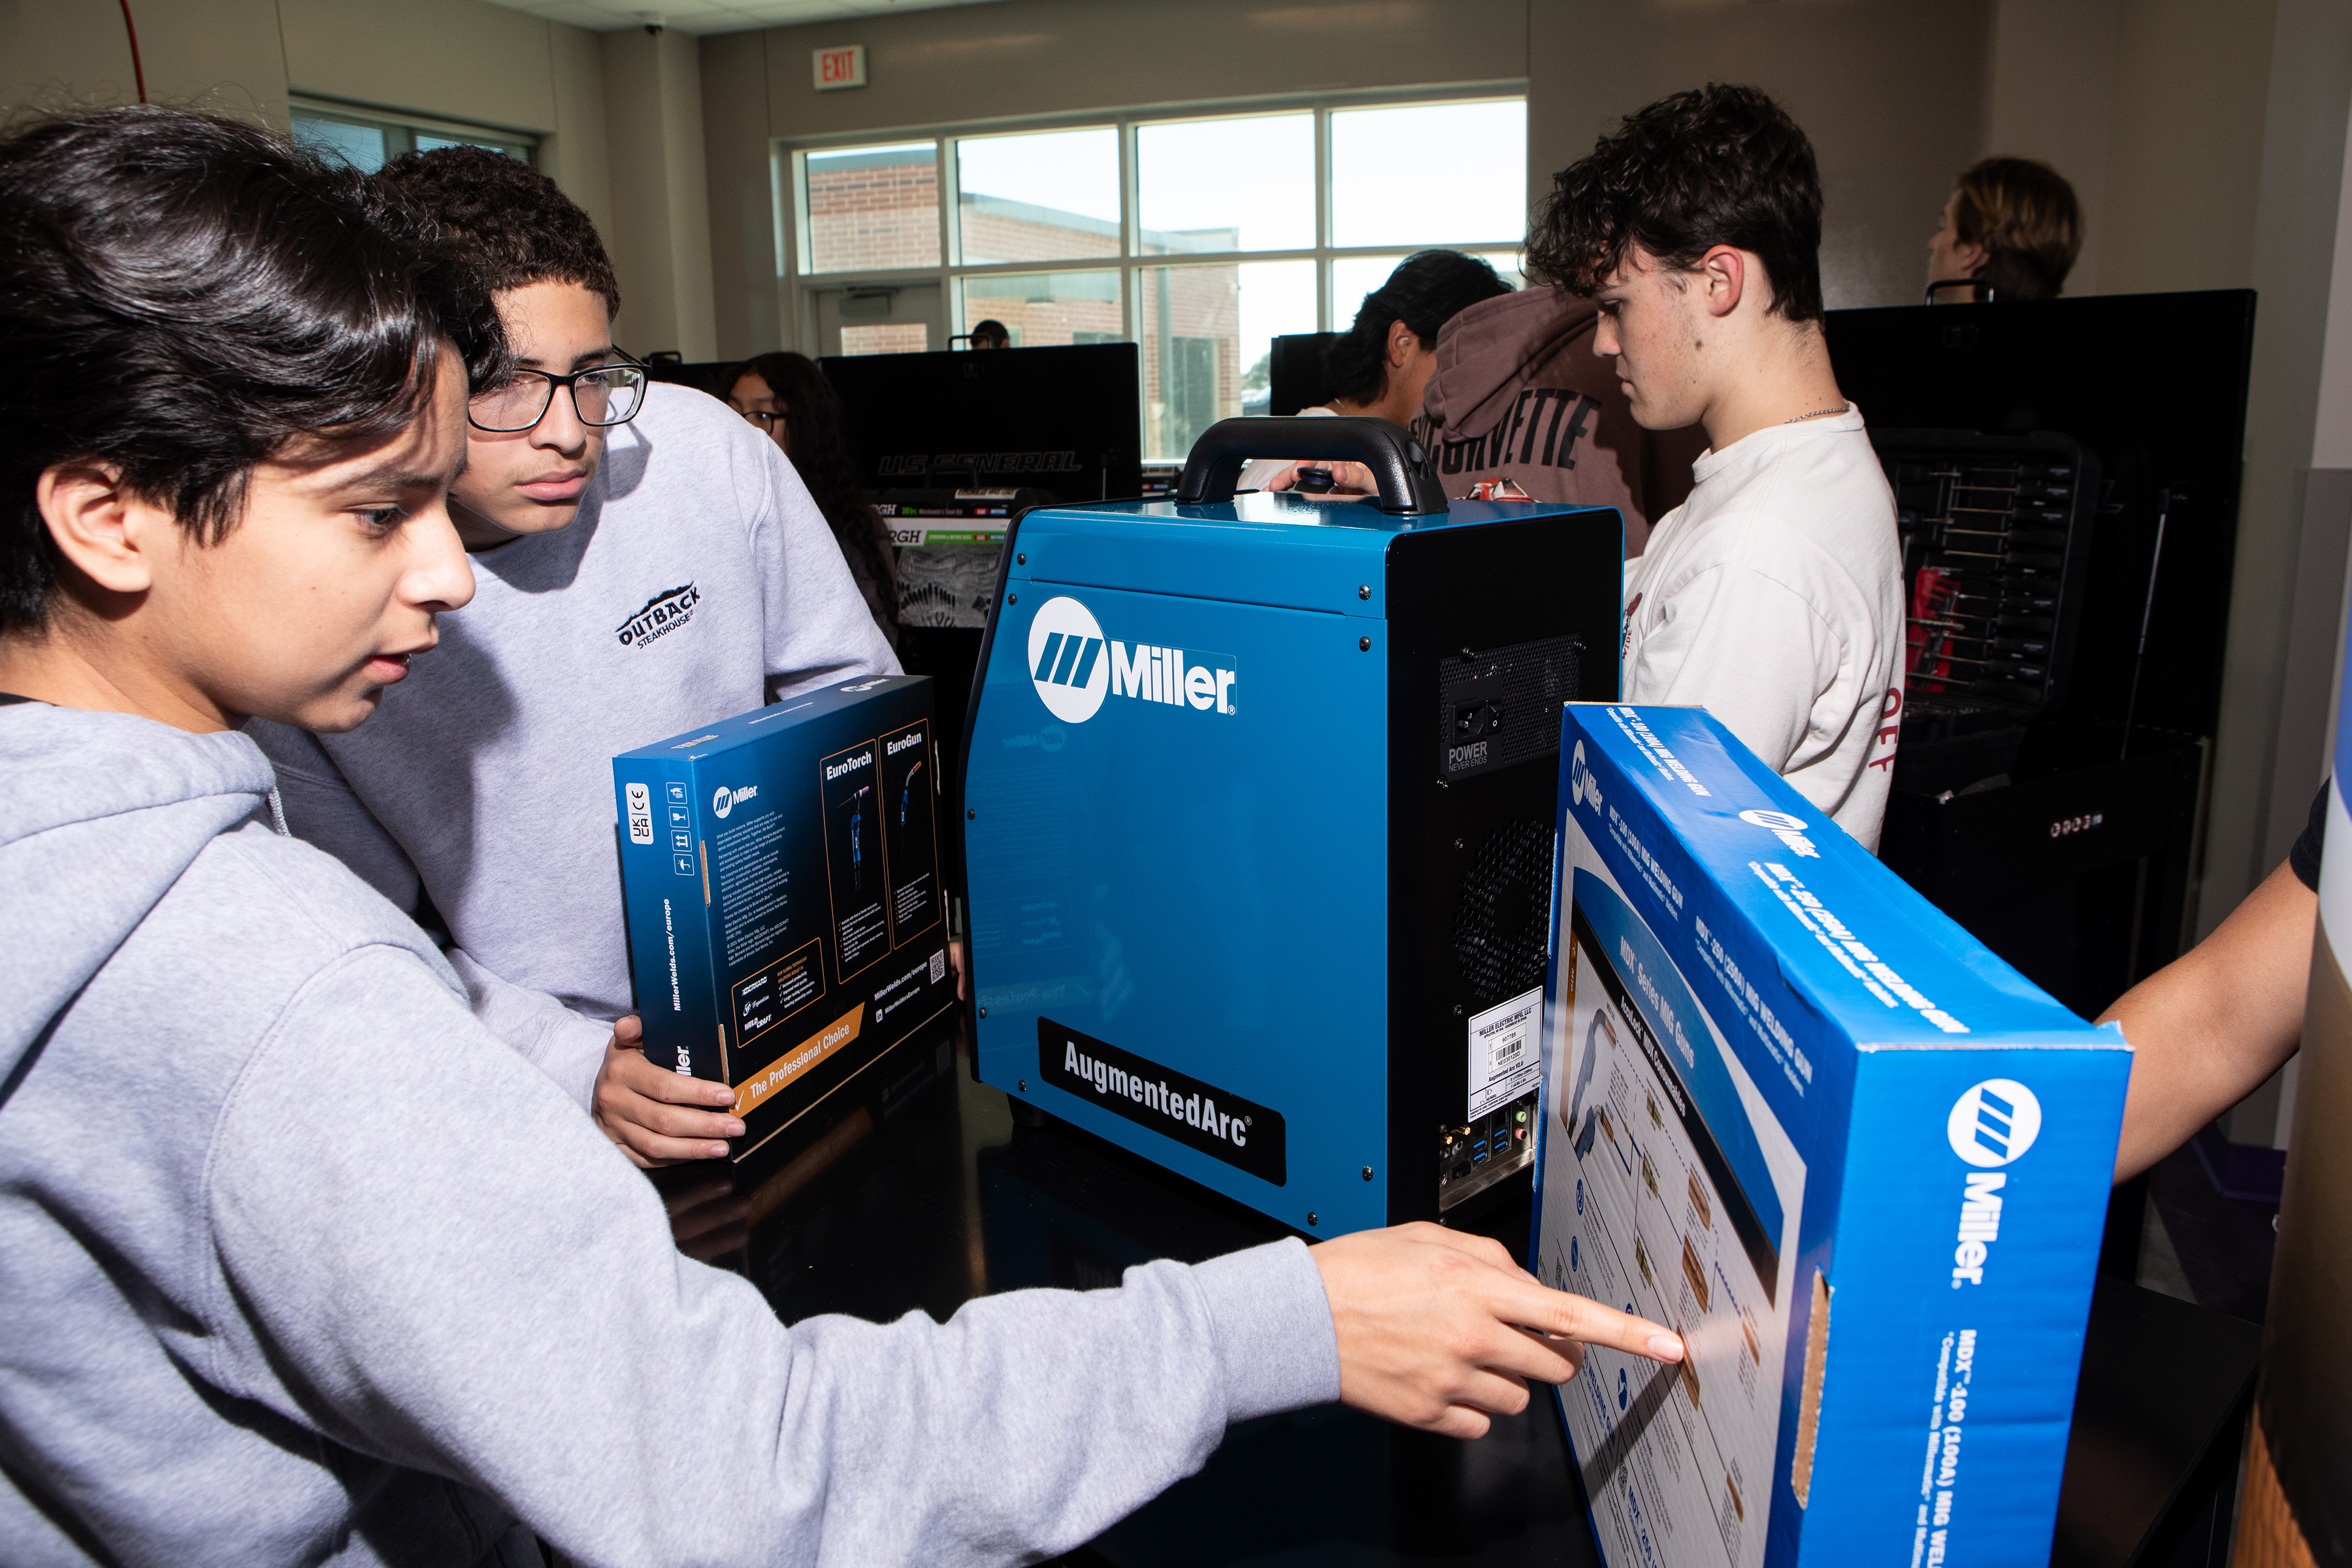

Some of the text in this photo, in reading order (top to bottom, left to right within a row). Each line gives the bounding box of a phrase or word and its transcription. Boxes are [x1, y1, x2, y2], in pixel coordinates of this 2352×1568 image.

[823, 50, 855, 83] EXIT
[619, 587, 701, 646] OUTBACK
[887, 731, 923, 757] EuroGun
[1448, 741, 1488, 765] POWER
[1653, 748, 1674, 759] MIG
[826, 751, 873, 781] EuroTorch
[1448, 755, 1488, 773] NEVER ENDS
[1663, 759, 1698, 783] WELDING
[1687, 783, 1712, 796] GUN
[717, 836, 732, 845] dependable
[1627, 829, 1641, 857] (100A)
[1641, 846, 1650, 868] MIG
[1650, 857, 1671, 894] WELDING
[1672, 885, 1683, 909] GUN
[664, 898, 682, 1012] MillerWelds.com/europe
[874, 962, 927, 1001] MillerWelds.com/europe
[1840, 940, 1878, 962] MIG
[1864, 962, 1935, 1009] WELDING
[1920, 1009, 1970, 1033] GUN
[885, 987, 920, 1014] MillerWeldersEurope
[1638, 962, 1659, 1011] Series
[1660, 996, 1674, 1036] MIG
[1675, 1021, 1694, 1068] Guns
[1479, 1025, 1494, 1036] MILLER
[1495, 1016, 1514, 1029] ELECTRIC
[1514, 1011, 1524, 1021] MFG.
[1502, 1032, 1516, 1043] 907789
[1745, 982, 1759, 1012] MIG
[1760, 1001, 1794, 1058] WELDING
[1794, 1048, 1812, 1084] GUN
[750, 1024, 849, 1098] The Professional Choice
[1488, 1068, 1509, 1082] Augmented
[1643, 1032, 1654, 1061] MDX
[1654, 1051, 1685, 1116] Consumables
[1588, 1364, 1616, 1448] WELDING GUN
[1930, 1405, 1942, 1430] with
[1936, 1426, 1961, 1486] (100A)
[1917, 1504, 1928, 1526] and
[1933, 1491, 1953, 1526] MIG
